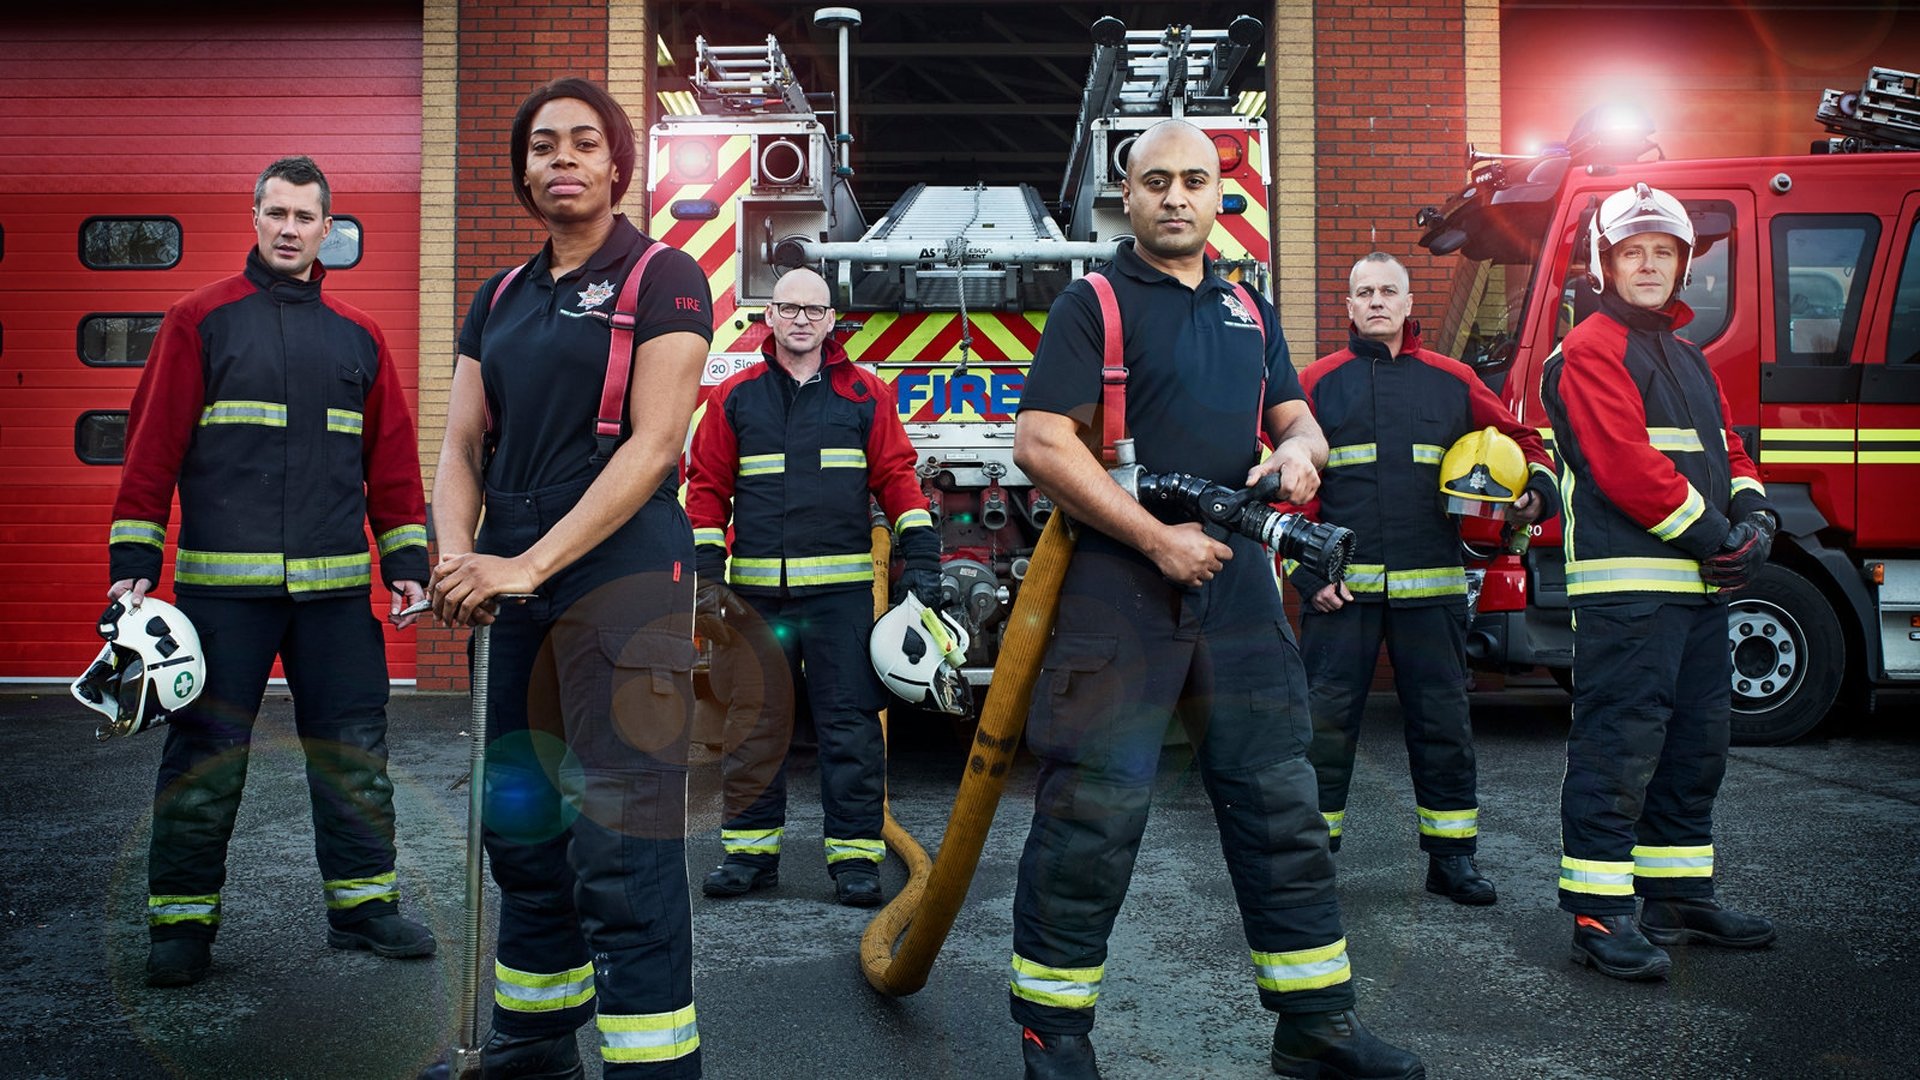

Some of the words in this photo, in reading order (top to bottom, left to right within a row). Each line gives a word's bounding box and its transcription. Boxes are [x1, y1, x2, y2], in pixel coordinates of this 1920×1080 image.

[675, 297, 701, 312] FIRE
[711, 364, 726, 374] 20
[898, 374, 1026, 414] FIRE
